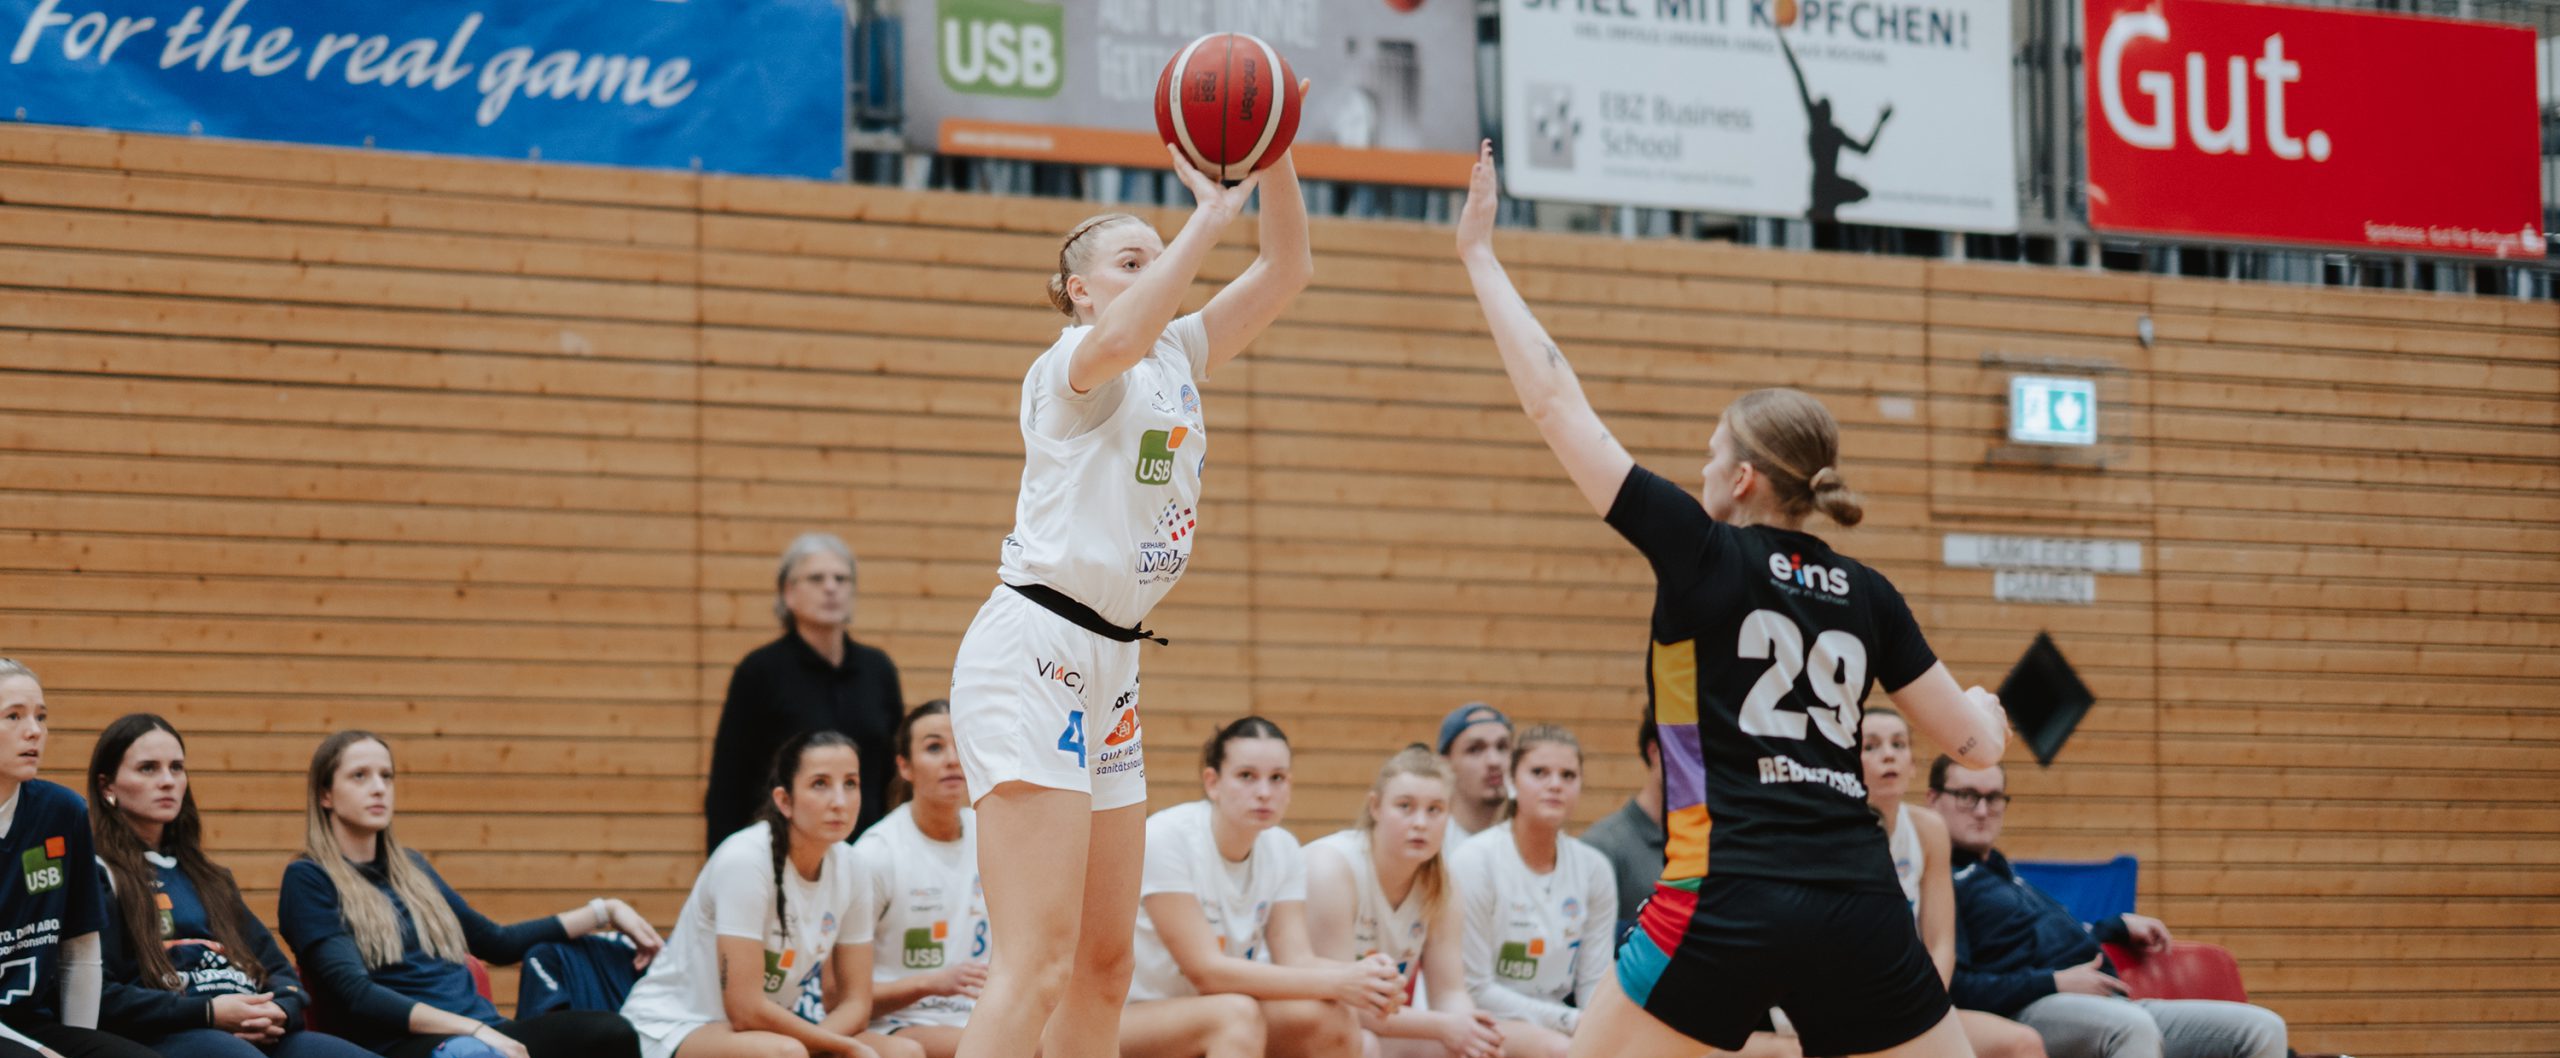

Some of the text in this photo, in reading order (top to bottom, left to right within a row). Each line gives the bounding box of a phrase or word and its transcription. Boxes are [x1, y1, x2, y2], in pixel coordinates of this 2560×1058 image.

[1750, 0, 1969, 48] KPFCHEN!
[10, 0, 698, 127] For the real game
[944, 18, 1059, 88] USB
[1239, 57, 1257, 120] molten
[2099, 11, 2332, 163] Gut.
[1652, 95, 1754, 133] Business
[1600, 127, 1682, 161] School
[1140, 458, 1172, 481] USB
[1769, 552, 1850, 596] eins
[1738, 609, 1867, 750] 29
[1057, 709, 1086, 768] 4
[26, 866, 61, 892] USB
[905, 948, 942, 967] USB
[1500, 958, 1534, 979] USB
